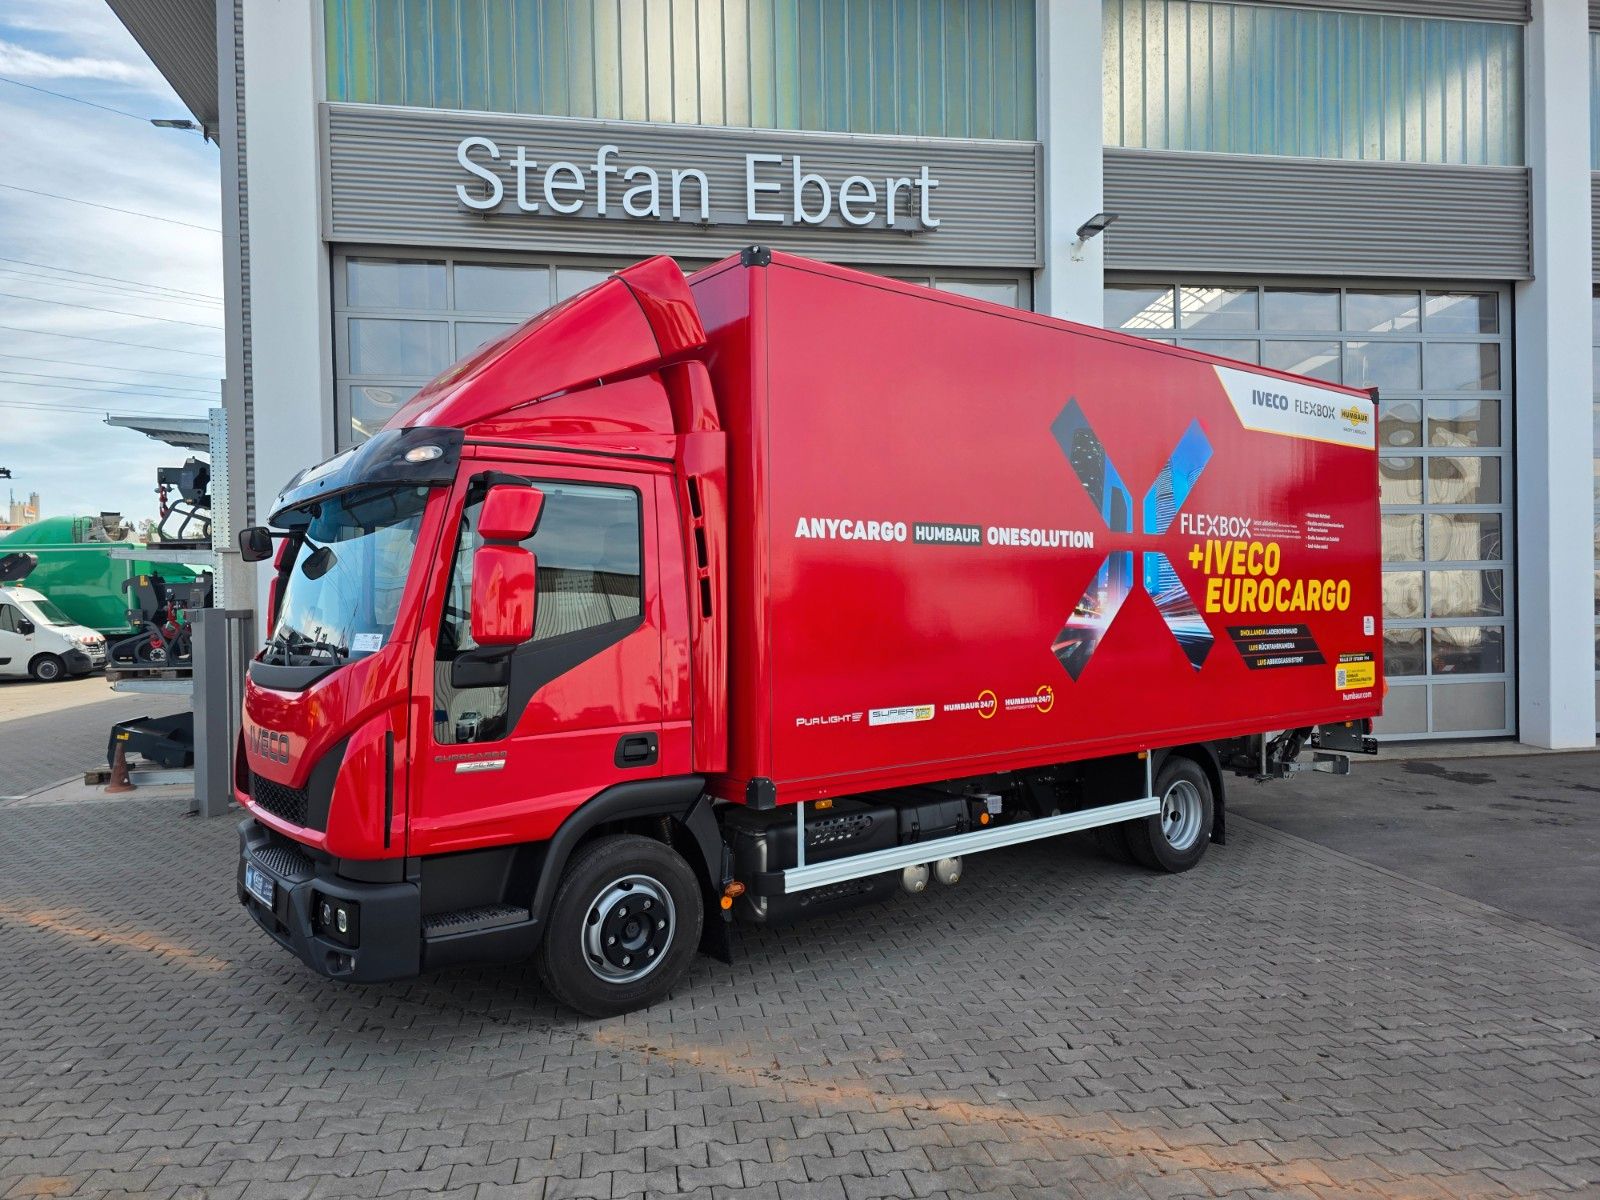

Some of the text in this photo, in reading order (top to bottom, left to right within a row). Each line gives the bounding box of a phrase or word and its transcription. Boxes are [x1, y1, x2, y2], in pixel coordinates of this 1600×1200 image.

[455, 136, 941, 230] Stefan Ebert
[1252, 389, 1336, 420] IVECO FLEXBOX
[1341, 410, 1368, 422] HUMBAUR
[795, 517, 1094, 549] ANYCARGO HUMBAUR ONESOLUTION
[1180, 513, 1251, 538] FLEXBOX
[1205, 578, 1351, 614] EUROCARGO
[873, 707, 914, 718] SUPER
[943, 702, 980, 712] HUMBAUR
[980, 700, 995, 709] 24/7
[1005, 695, 1052, 706] HUMBAUR 24/7
[250, 725, 289, 765] IVECO
